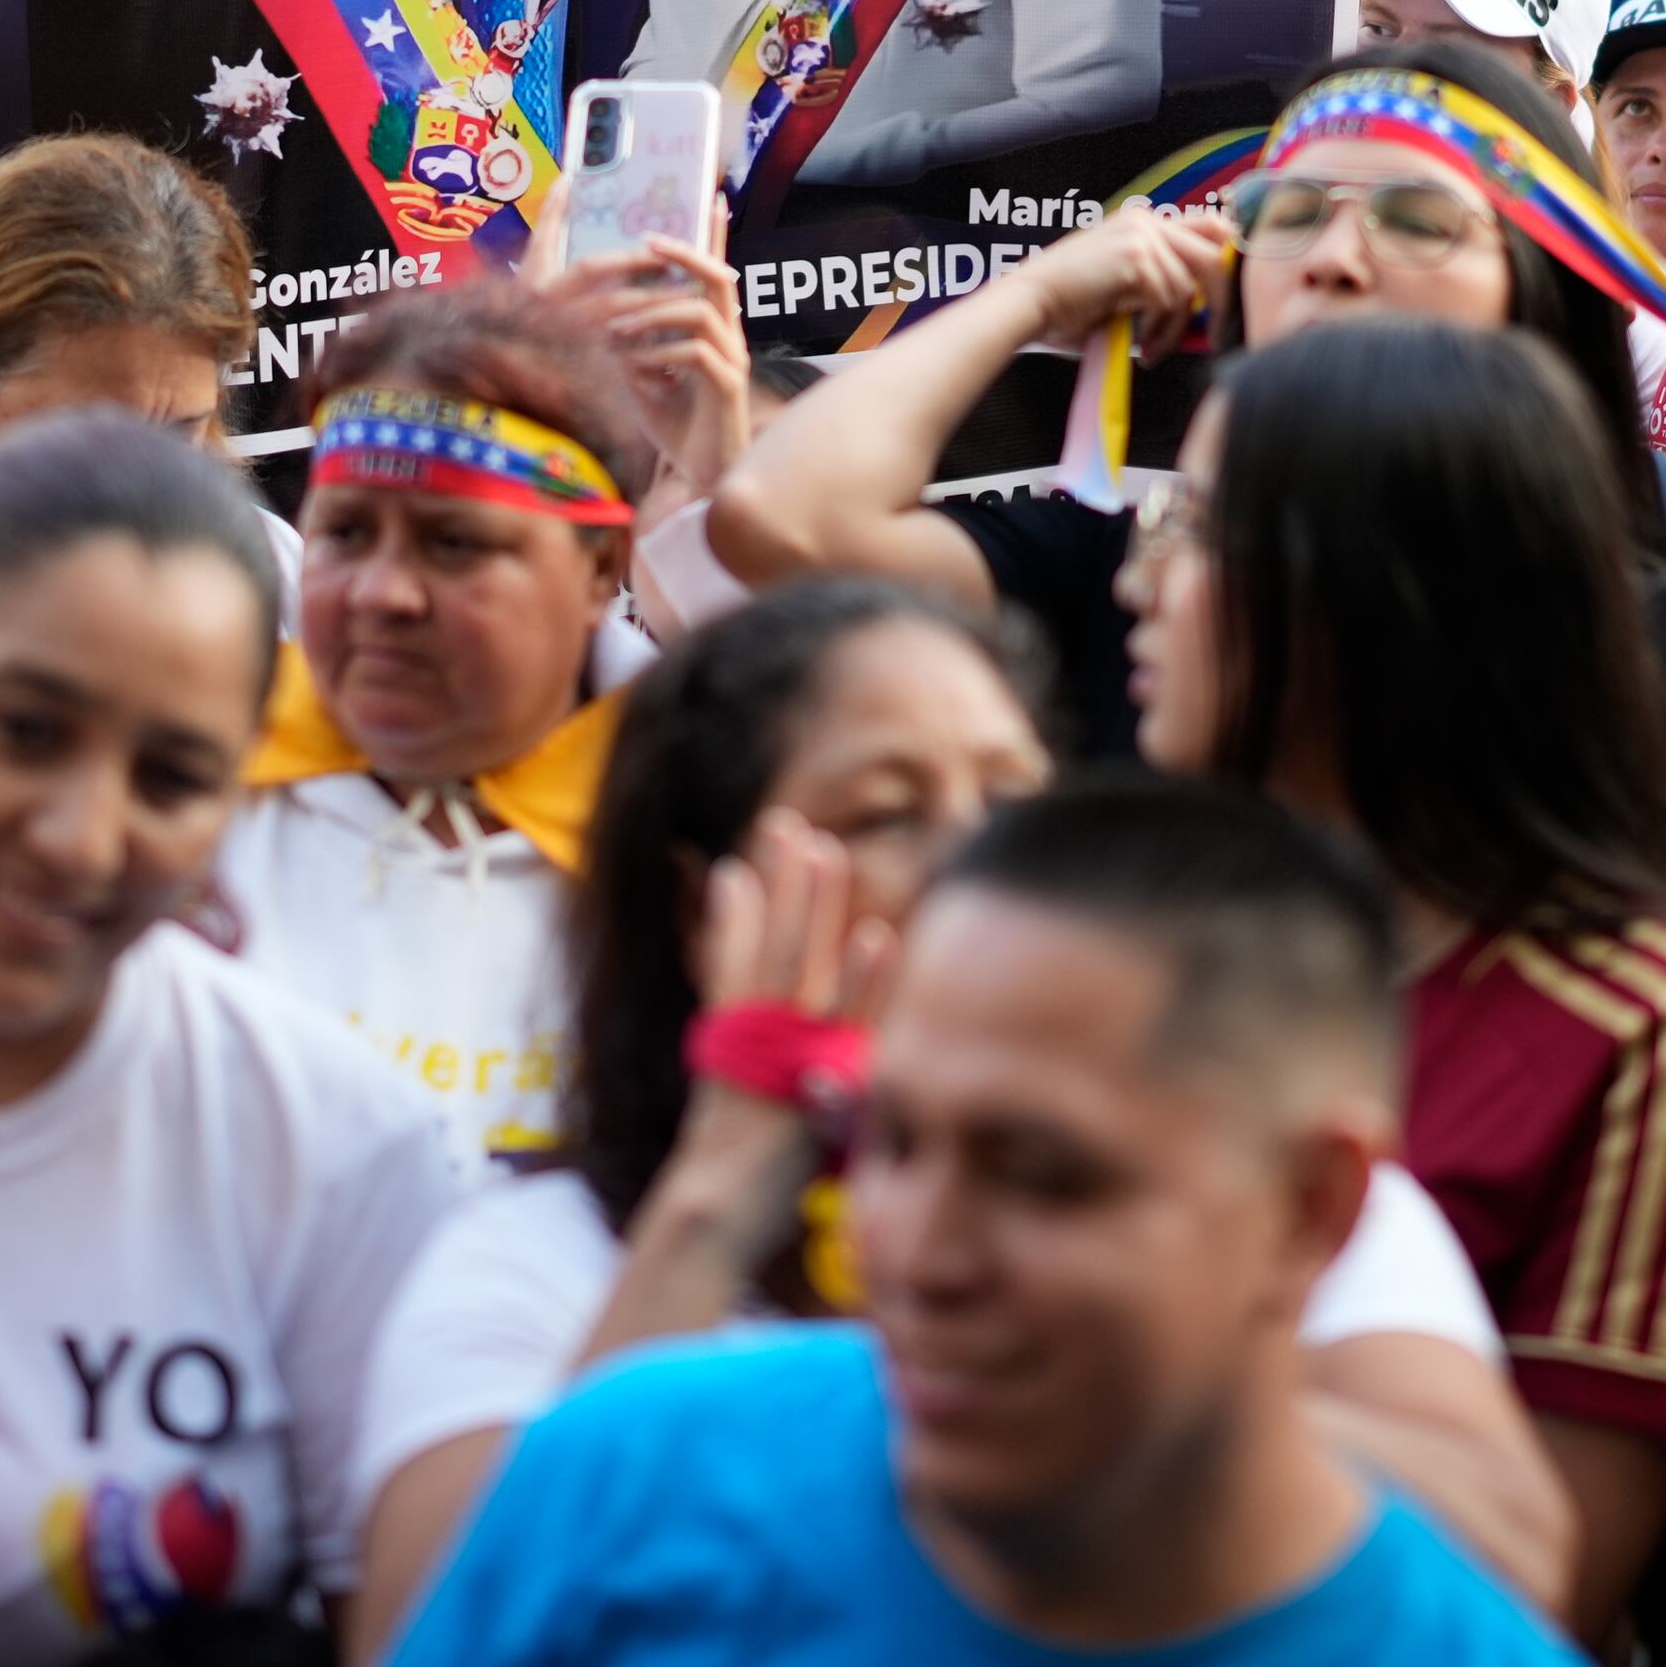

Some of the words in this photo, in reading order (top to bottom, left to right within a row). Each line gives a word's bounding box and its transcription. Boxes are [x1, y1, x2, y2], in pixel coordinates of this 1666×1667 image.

[968, 188, 1104, 230] María
[249, 248, 442, 310] González
[58, 1332, 238, 1447] YO
